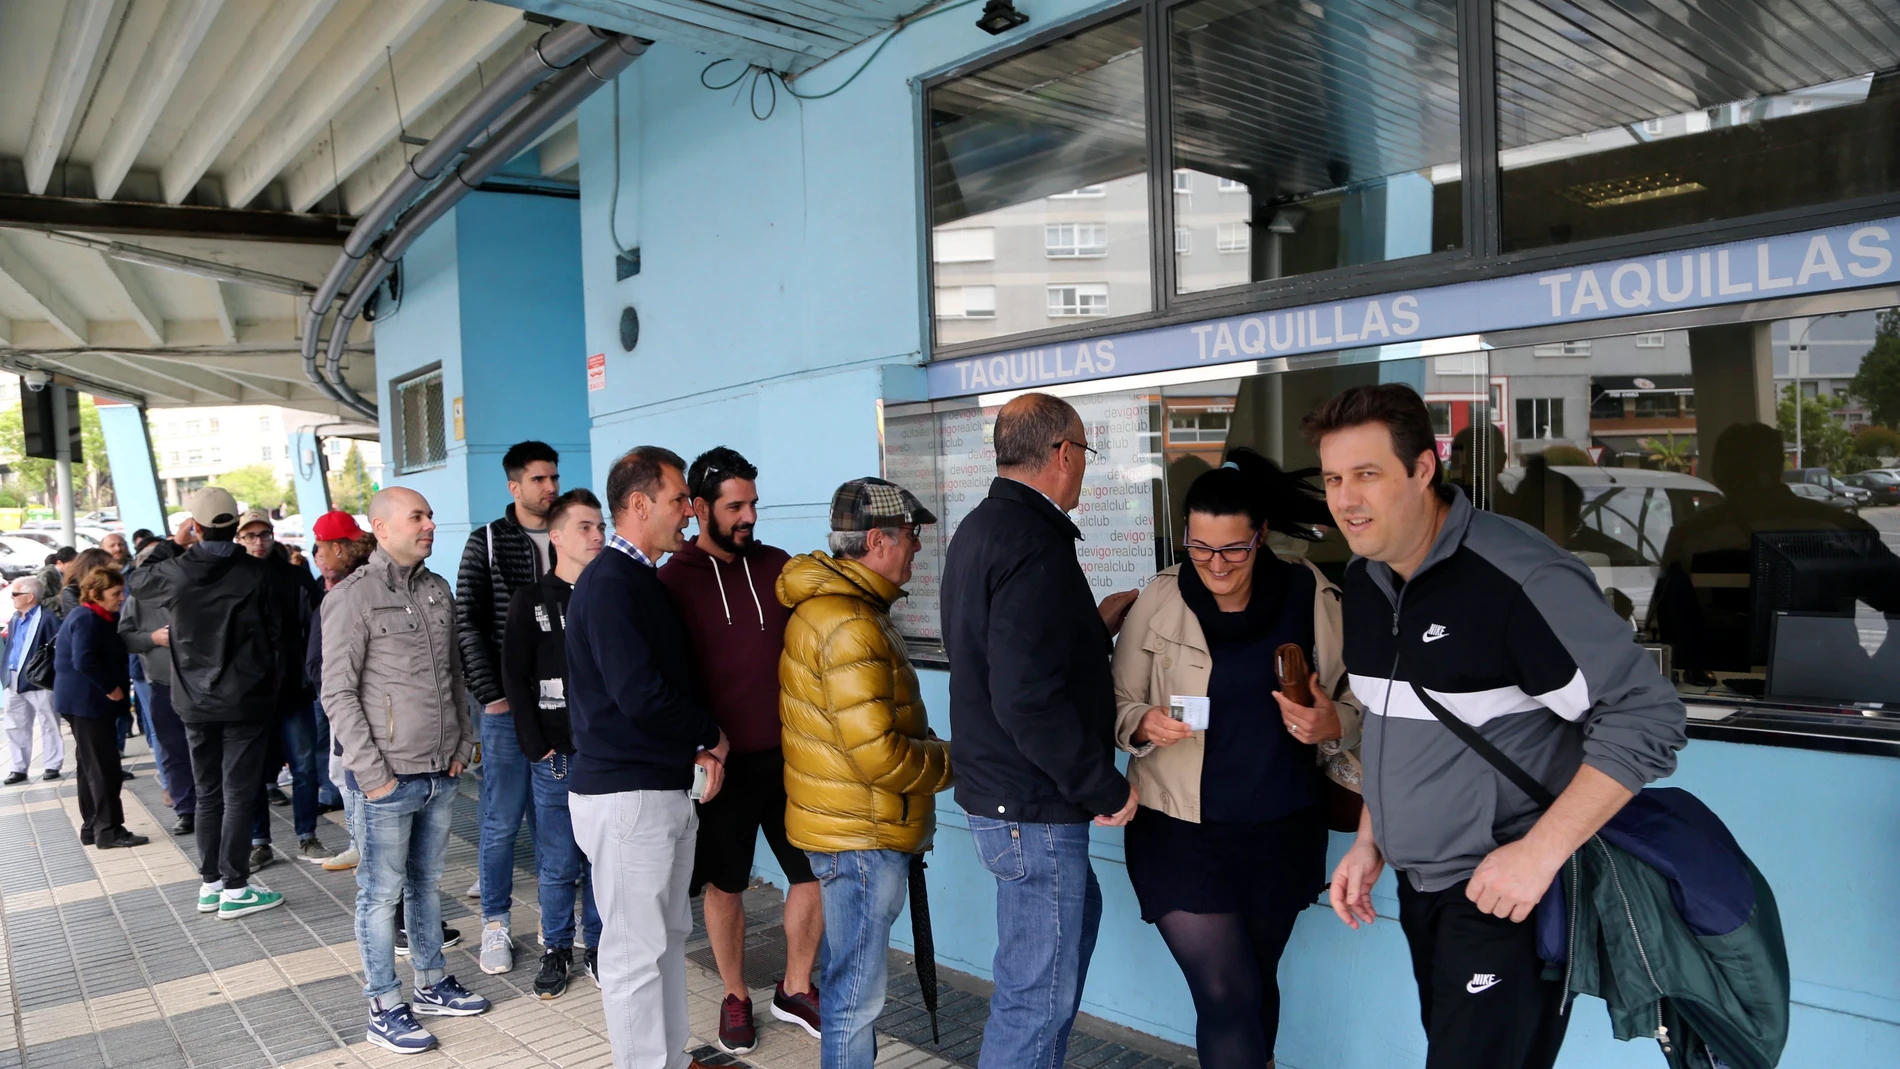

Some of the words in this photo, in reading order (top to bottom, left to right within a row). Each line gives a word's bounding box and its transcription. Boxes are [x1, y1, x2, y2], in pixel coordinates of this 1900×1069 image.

[1539, 226, 1893, 317] TAQUILLAS
[1191, 295, 1420, 360] TAQUILLAS
[955, 339, 1116, 390] TAQUILLAS
[1429, 623, 1446, 636] NIKE
[1472, 973, 1496, 986] NIKE
